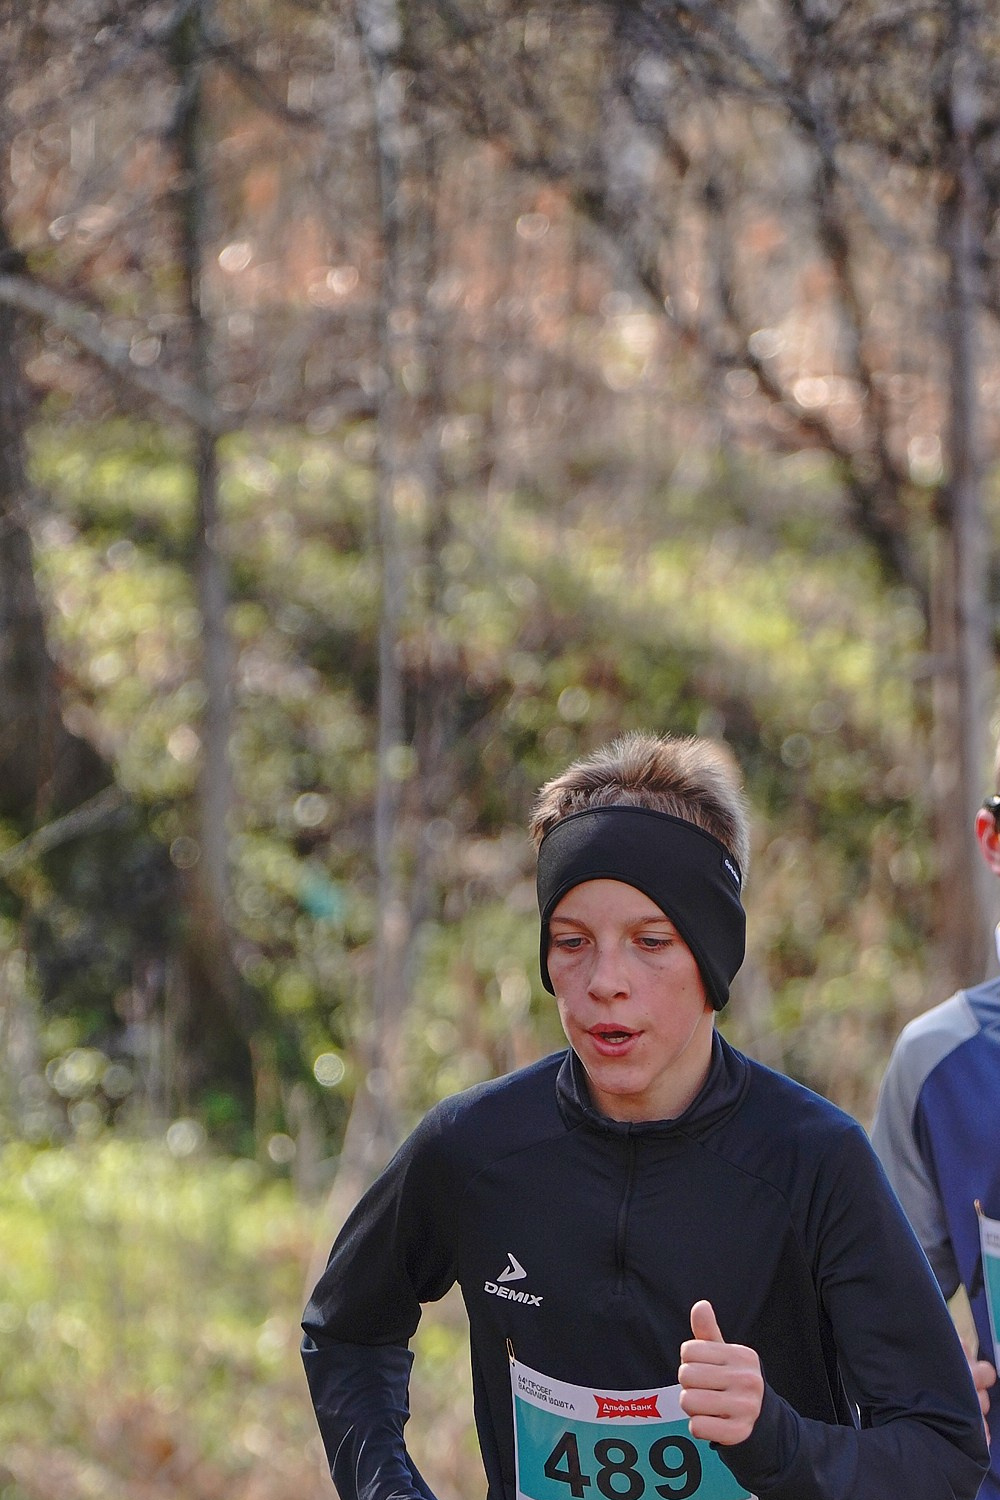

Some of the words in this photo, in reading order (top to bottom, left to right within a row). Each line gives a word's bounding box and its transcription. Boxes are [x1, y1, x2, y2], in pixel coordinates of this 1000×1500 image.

[484, 1281, 544, 1307] DEMIX
[603, 1403, 630, 1413] Альфа
[630, 1403, 653, 1411] Банк
